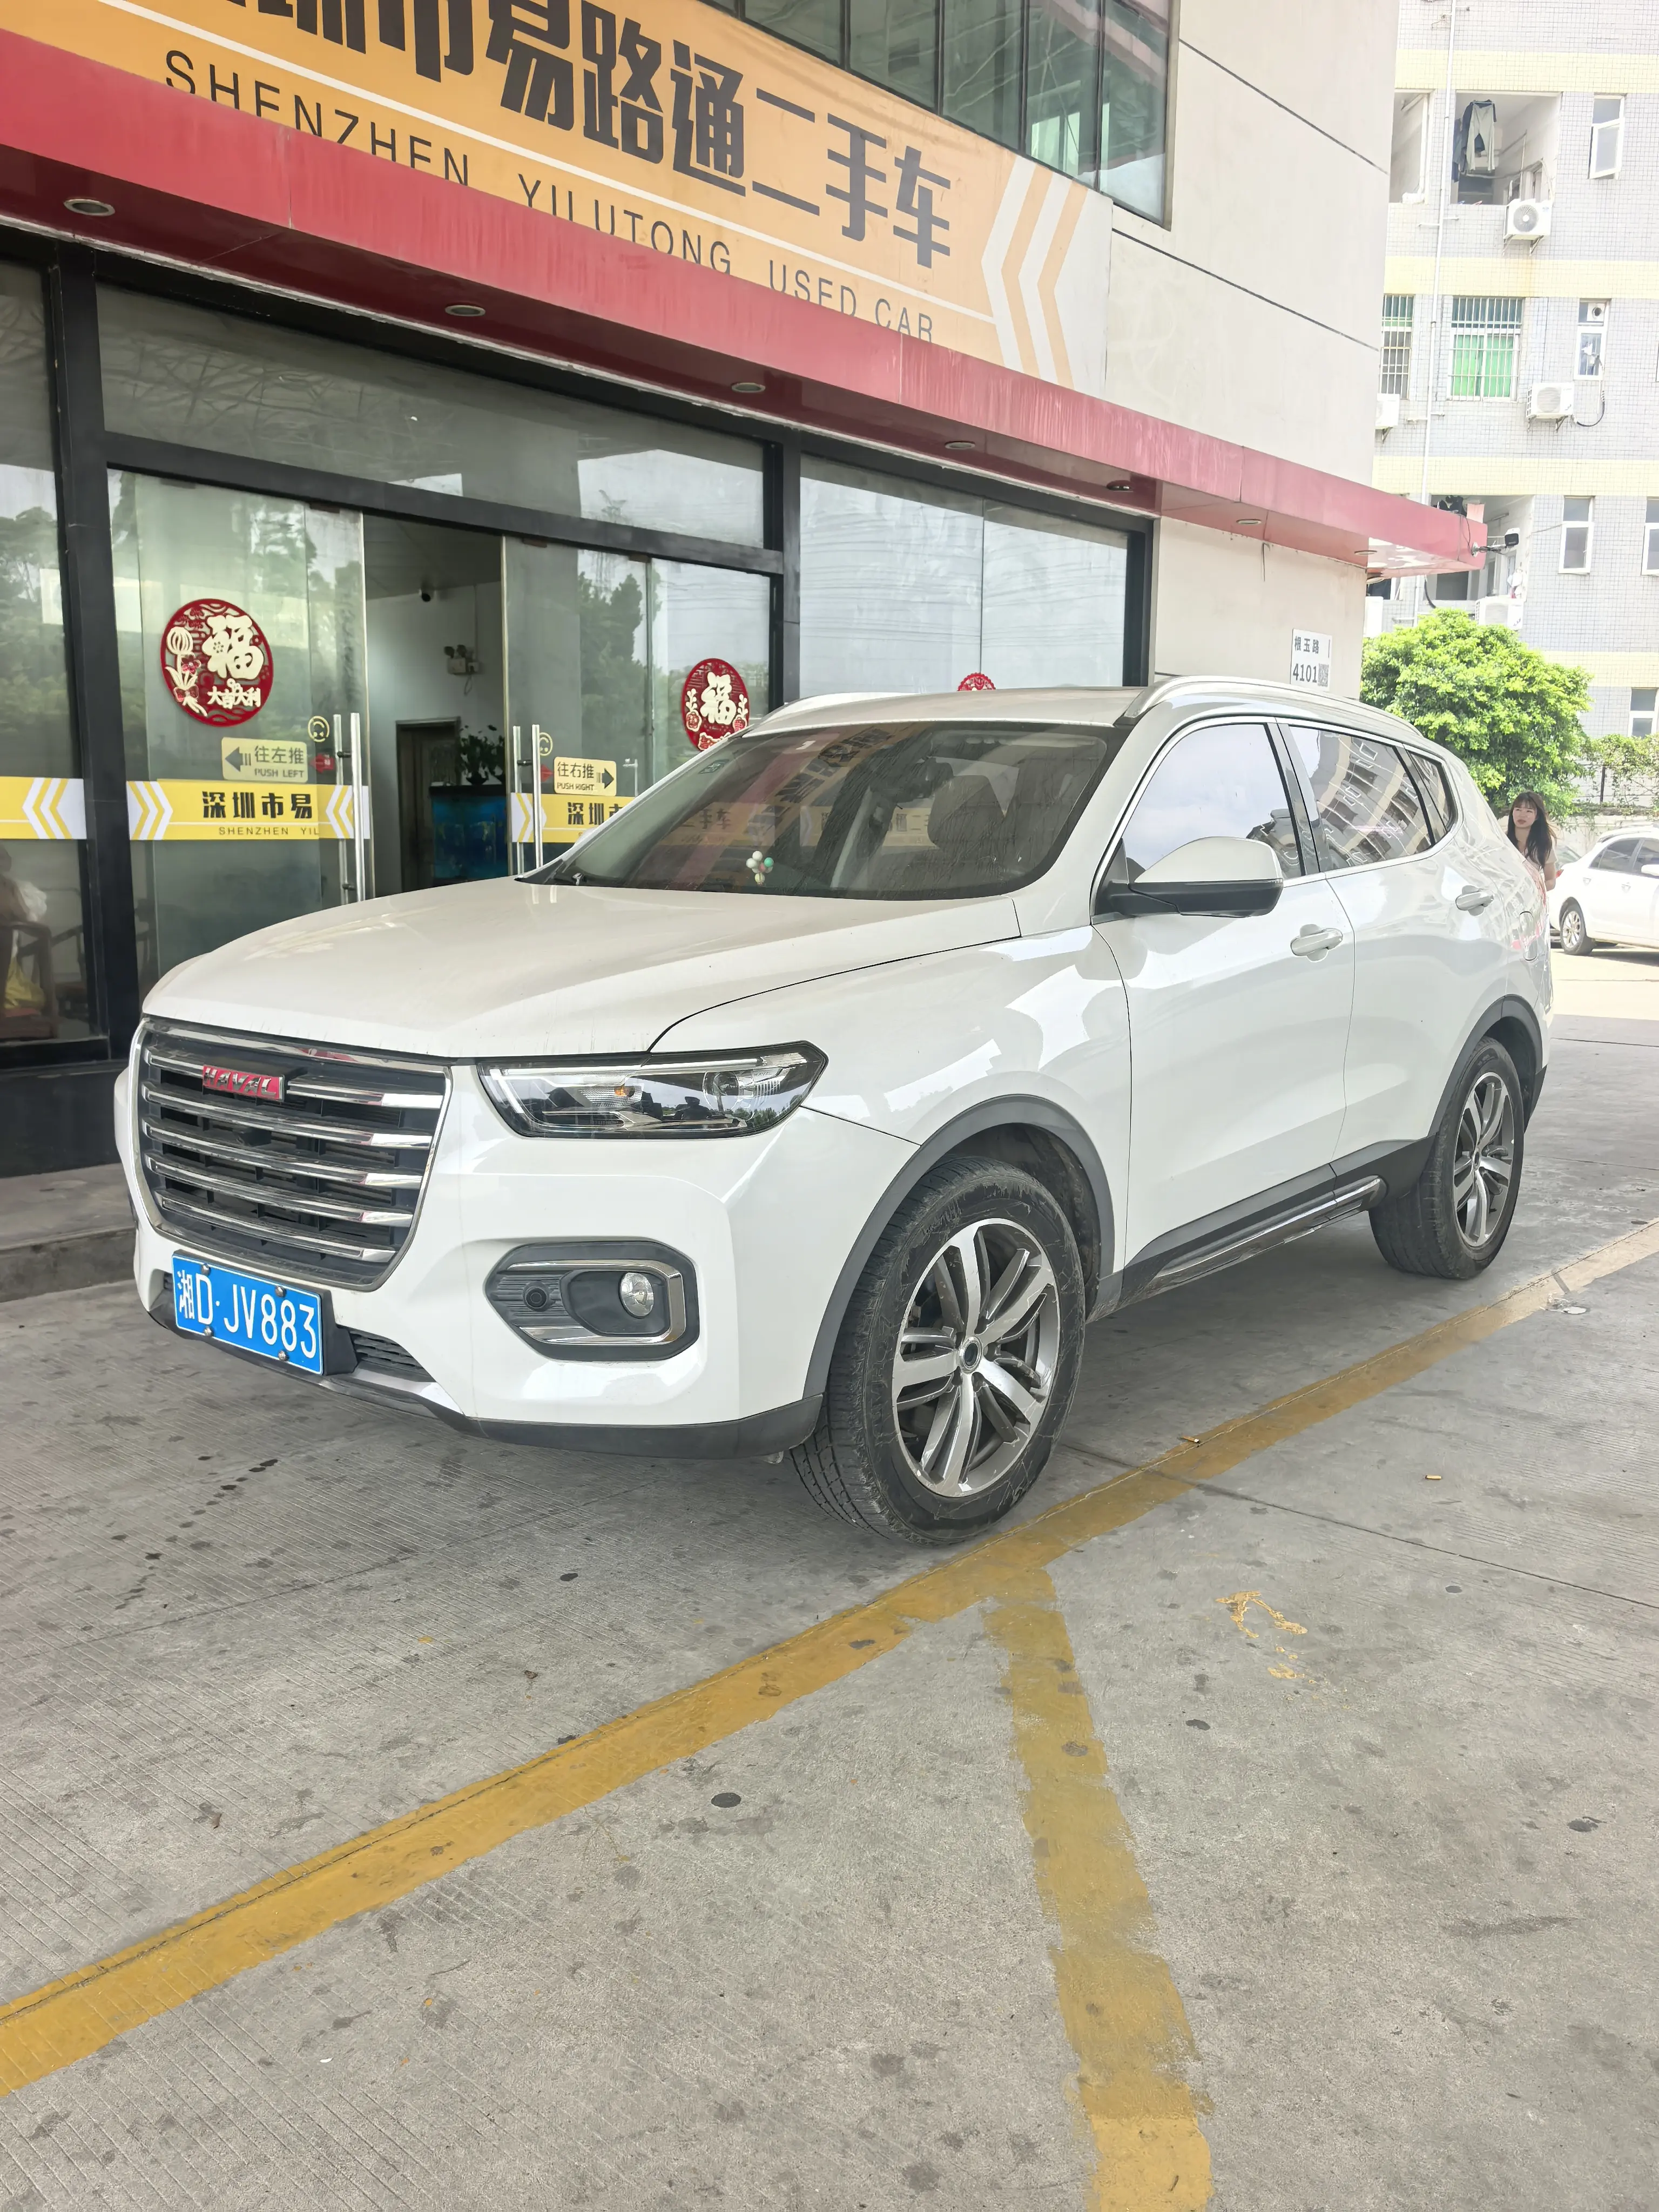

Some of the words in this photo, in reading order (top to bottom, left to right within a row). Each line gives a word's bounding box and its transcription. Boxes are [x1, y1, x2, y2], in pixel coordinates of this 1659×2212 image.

[875, 298, 933, 343] CAR
[202, 615, 265, 680] 福
[1294, 636, 1319, 654] 根玉路
[1293, 663, 1317, 683] 4101
[207, 685, 261, 709] 大吉大利
[700, 672, 737, 725] 福
[254, 745, 305, 765] 往左推
[254, 768, 279, 777] PUSH
[282, 770, 305, 778] LEFT
[557, 761, 594, 779] 往右推
[557, 782, 574, 790] PUSH
[575, 783, 595, 791] RIGHT
[202, 791, 313, 819] 深圳市易
[219, 827, 289, 835] SHENZHEN
[204, 1067, 276, 1096] HAVAL
